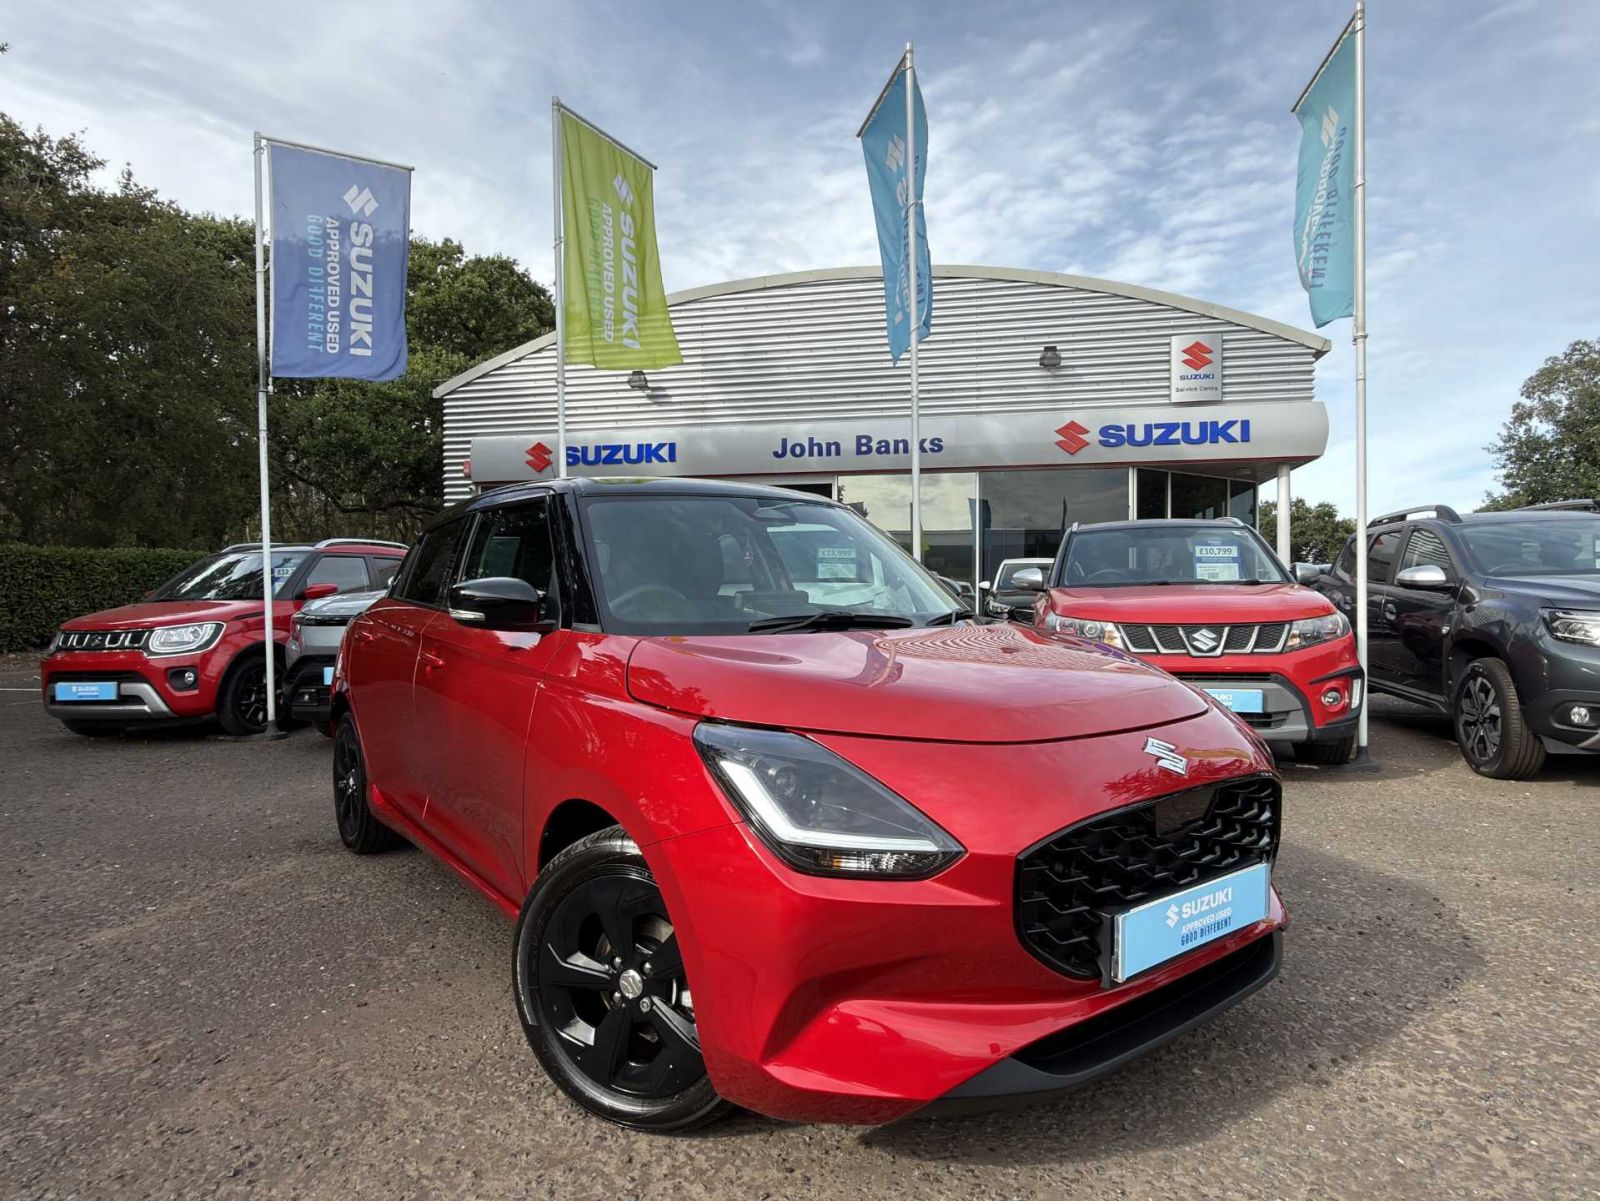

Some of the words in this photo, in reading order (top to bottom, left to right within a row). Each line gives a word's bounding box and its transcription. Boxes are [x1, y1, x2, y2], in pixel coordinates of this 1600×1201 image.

[307, 214, 324, 258] GOOD
[601, 201, 615, 293] APPROVED
[326, 216, 340, 308] APPROVED
[620, 211, 641, 351] SUZUKI
[308, 266, 325, 353] DIFFERENT
[350, 221, 374, 357] SUZUKI
[326, 310, 340, 355] USED
[603, 296, 616, 343] USED
[566, 442, 677, 466] SUZUKI
[772, 437, 842, 459] John
[1098, 419, 1251, 448] SUZUKI
[1200, 547, 1232, 555] £10,799
[1181, 914, 1216, 935] APPROVED
[1215, 907, 1233, 921] USED
[1182, 887, 1233, 919] SUZUKI
[1181, 931, 1198, 947] GOOD
[1199, 917, 1232, 939] DIFFERENT
